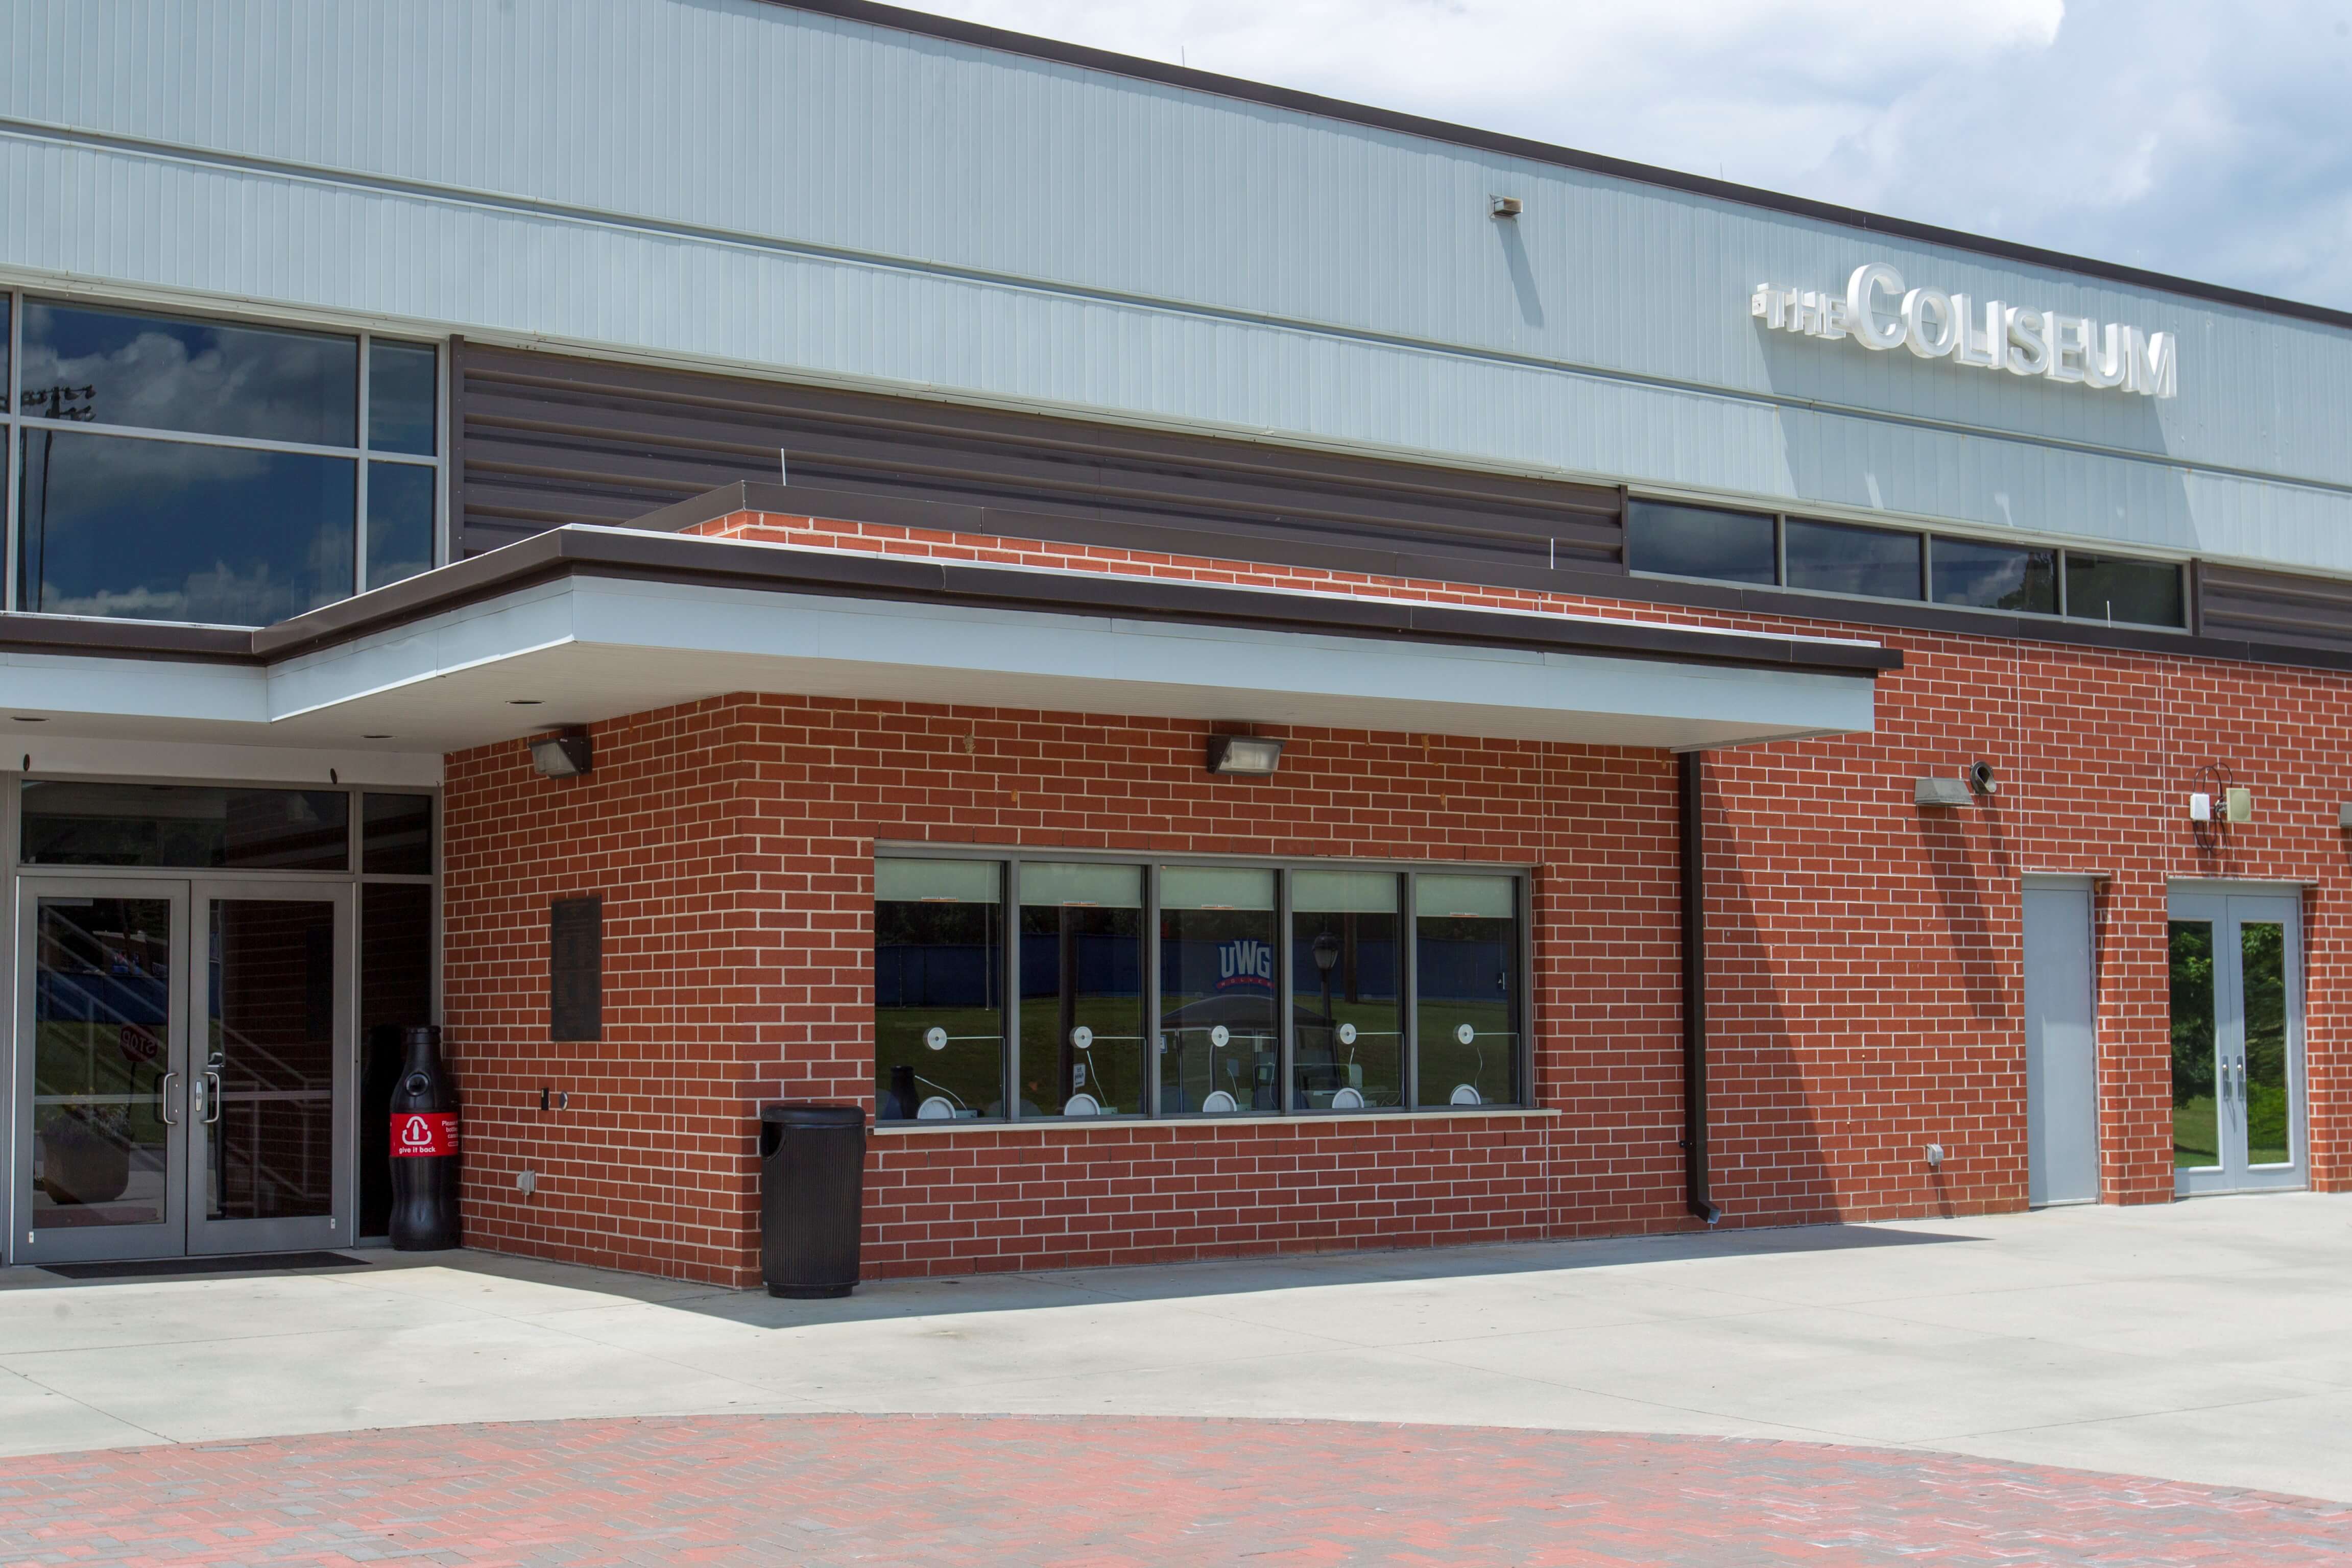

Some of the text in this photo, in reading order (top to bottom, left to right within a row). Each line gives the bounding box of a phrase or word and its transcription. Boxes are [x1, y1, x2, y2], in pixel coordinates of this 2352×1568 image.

[1752, 262, 2177, 398] THE COLISEUM
[1219, 940, 1270, 979] UWG
